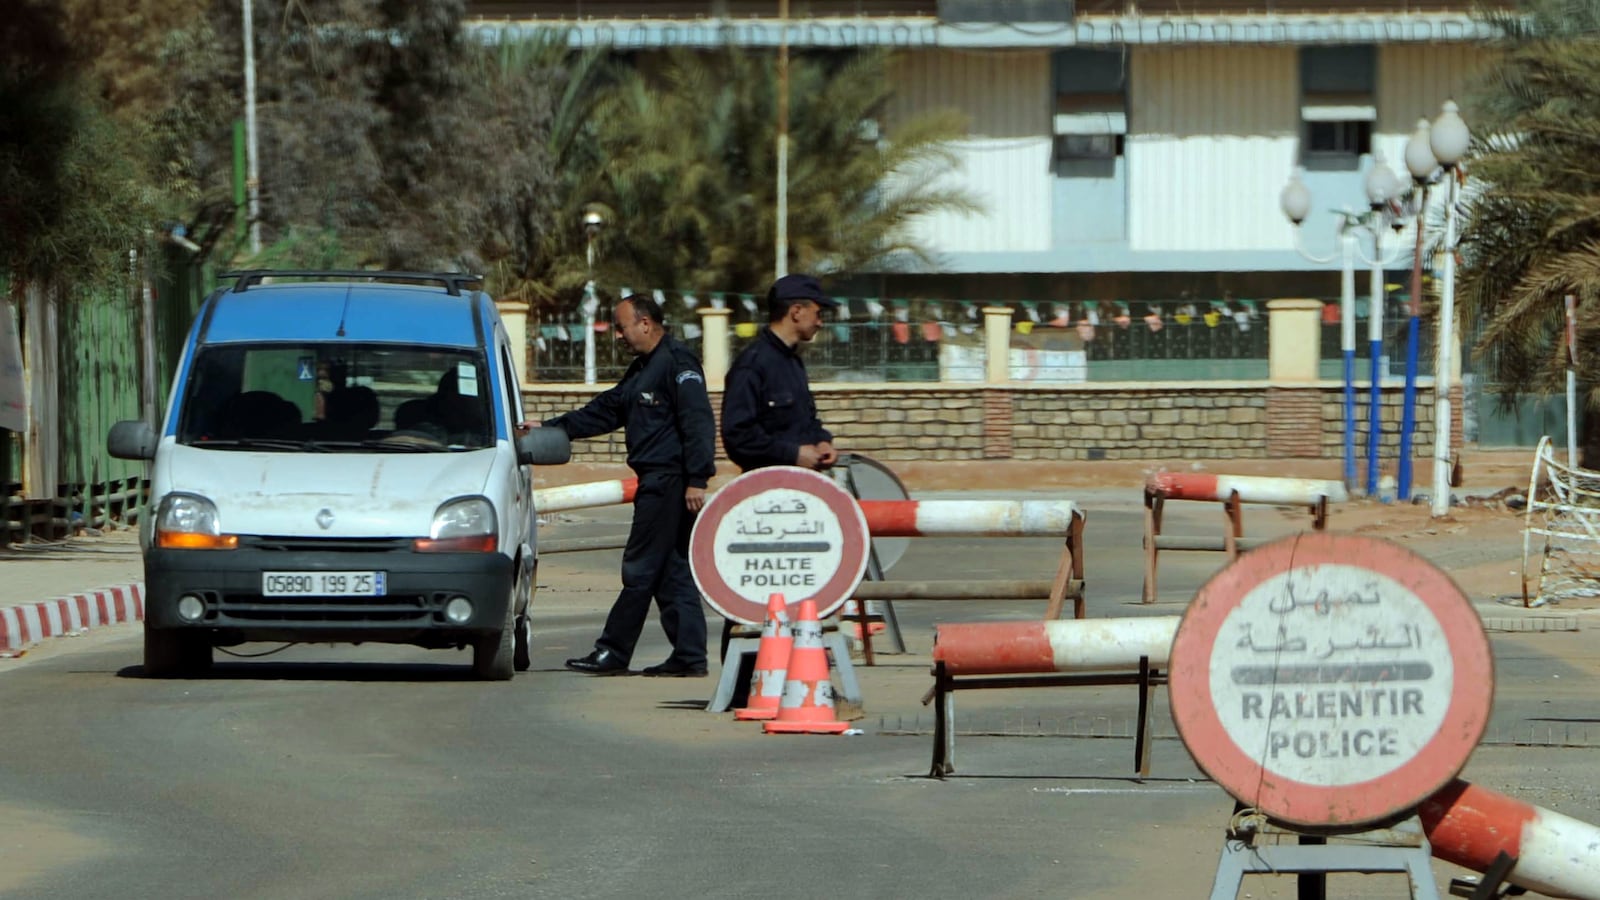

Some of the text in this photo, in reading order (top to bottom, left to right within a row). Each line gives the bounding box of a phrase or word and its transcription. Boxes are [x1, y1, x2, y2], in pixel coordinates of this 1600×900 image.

[754, 499, 807, 514] قف
[736, 519, 824, 540] الشرطة
[745, 558, 811, 570] HALTE
[266, 575, 371, 593] 05890 199 25
[740, 574, 815, 586] POLICE
[1269, 580, 1381, 615] تمهل
[1236, 622, 1421, 659] الشرطة
[1242, 688, 1424, 719] RALENTIR
[1270, 729, 1398, 759] POLICE
